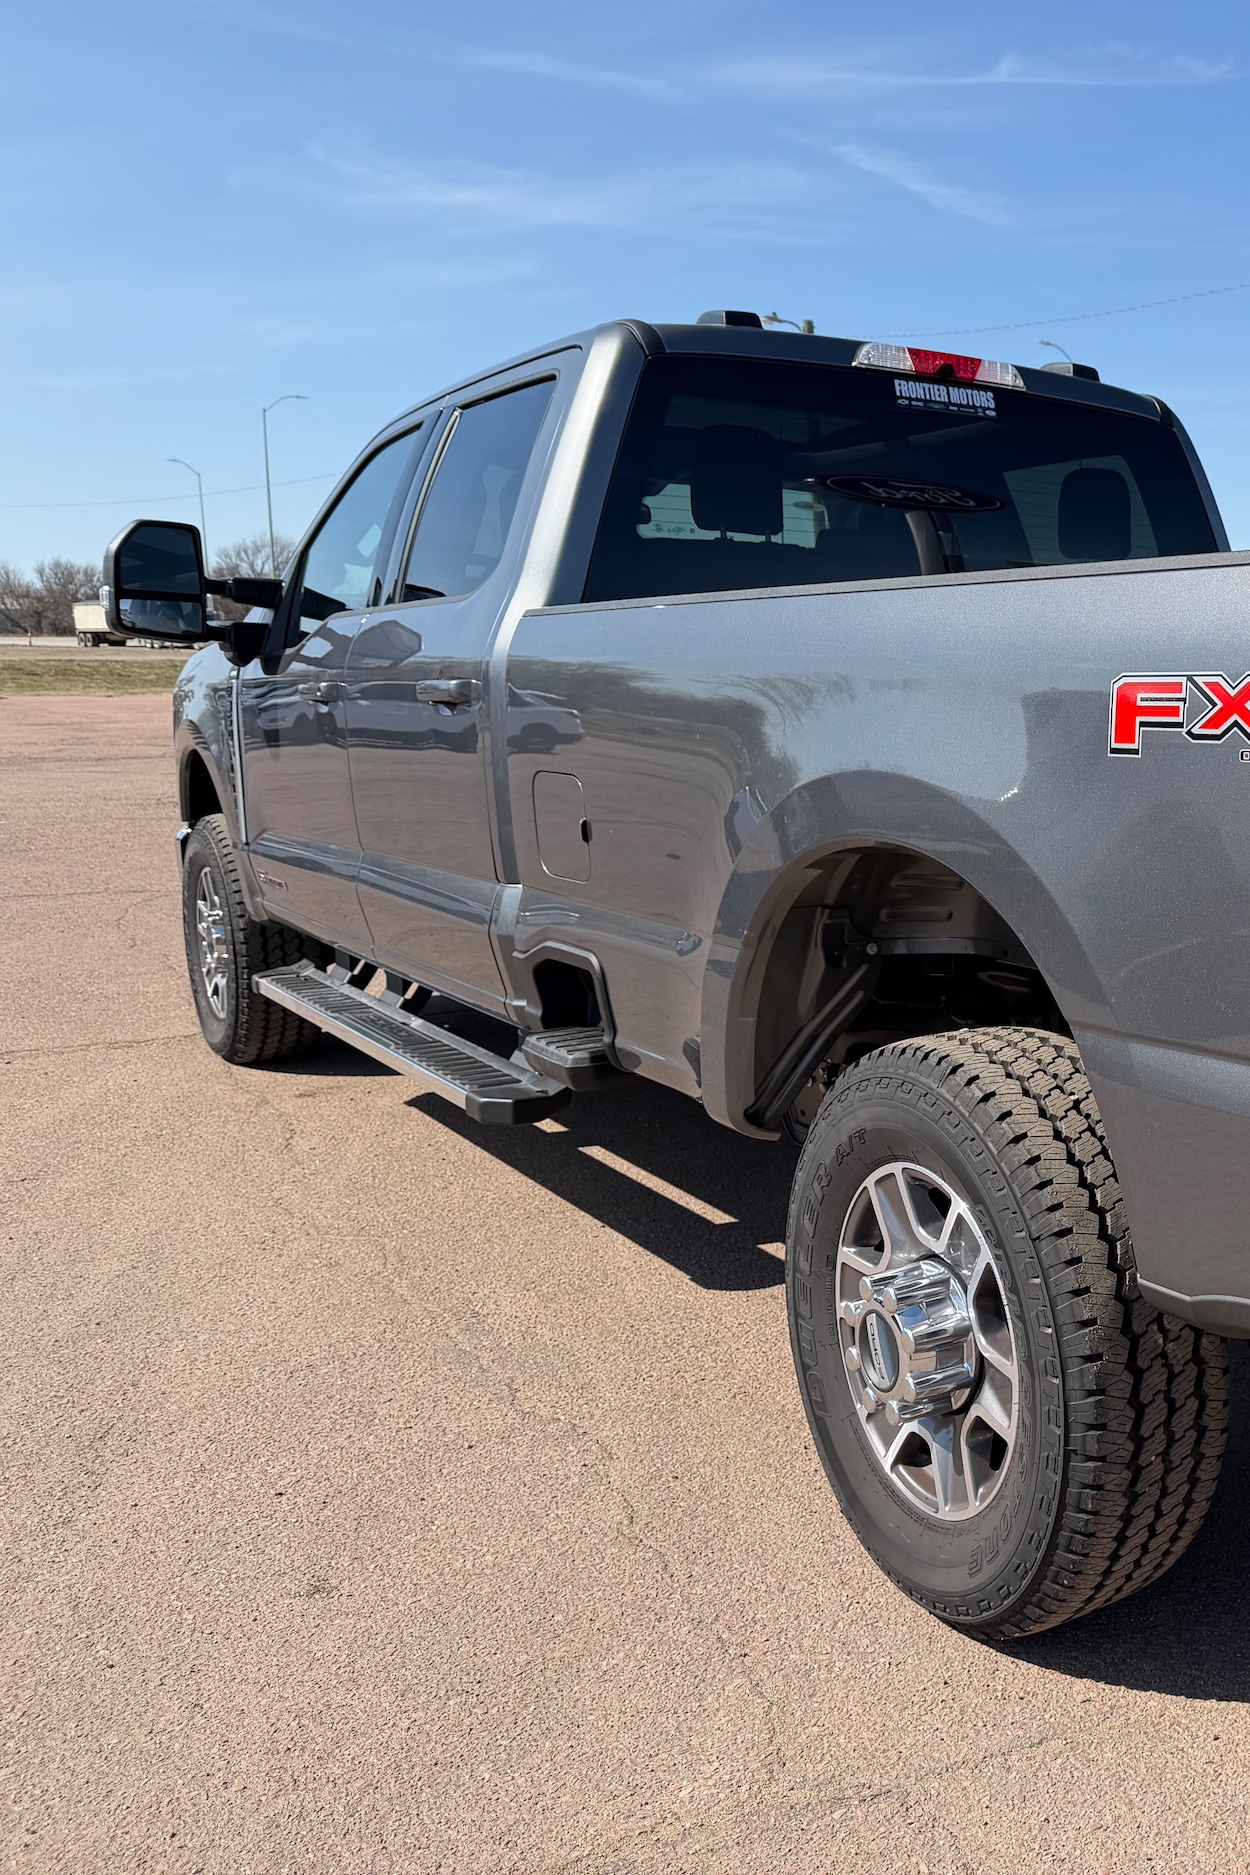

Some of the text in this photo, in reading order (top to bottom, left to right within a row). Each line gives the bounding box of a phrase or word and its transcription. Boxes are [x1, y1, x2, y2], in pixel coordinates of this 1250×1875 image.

[893, 378, 949, 403] FRONTIER
[948, 386, 996, 409] MOTORS
[795, 1125, 867, 1418] DUELER A/T
